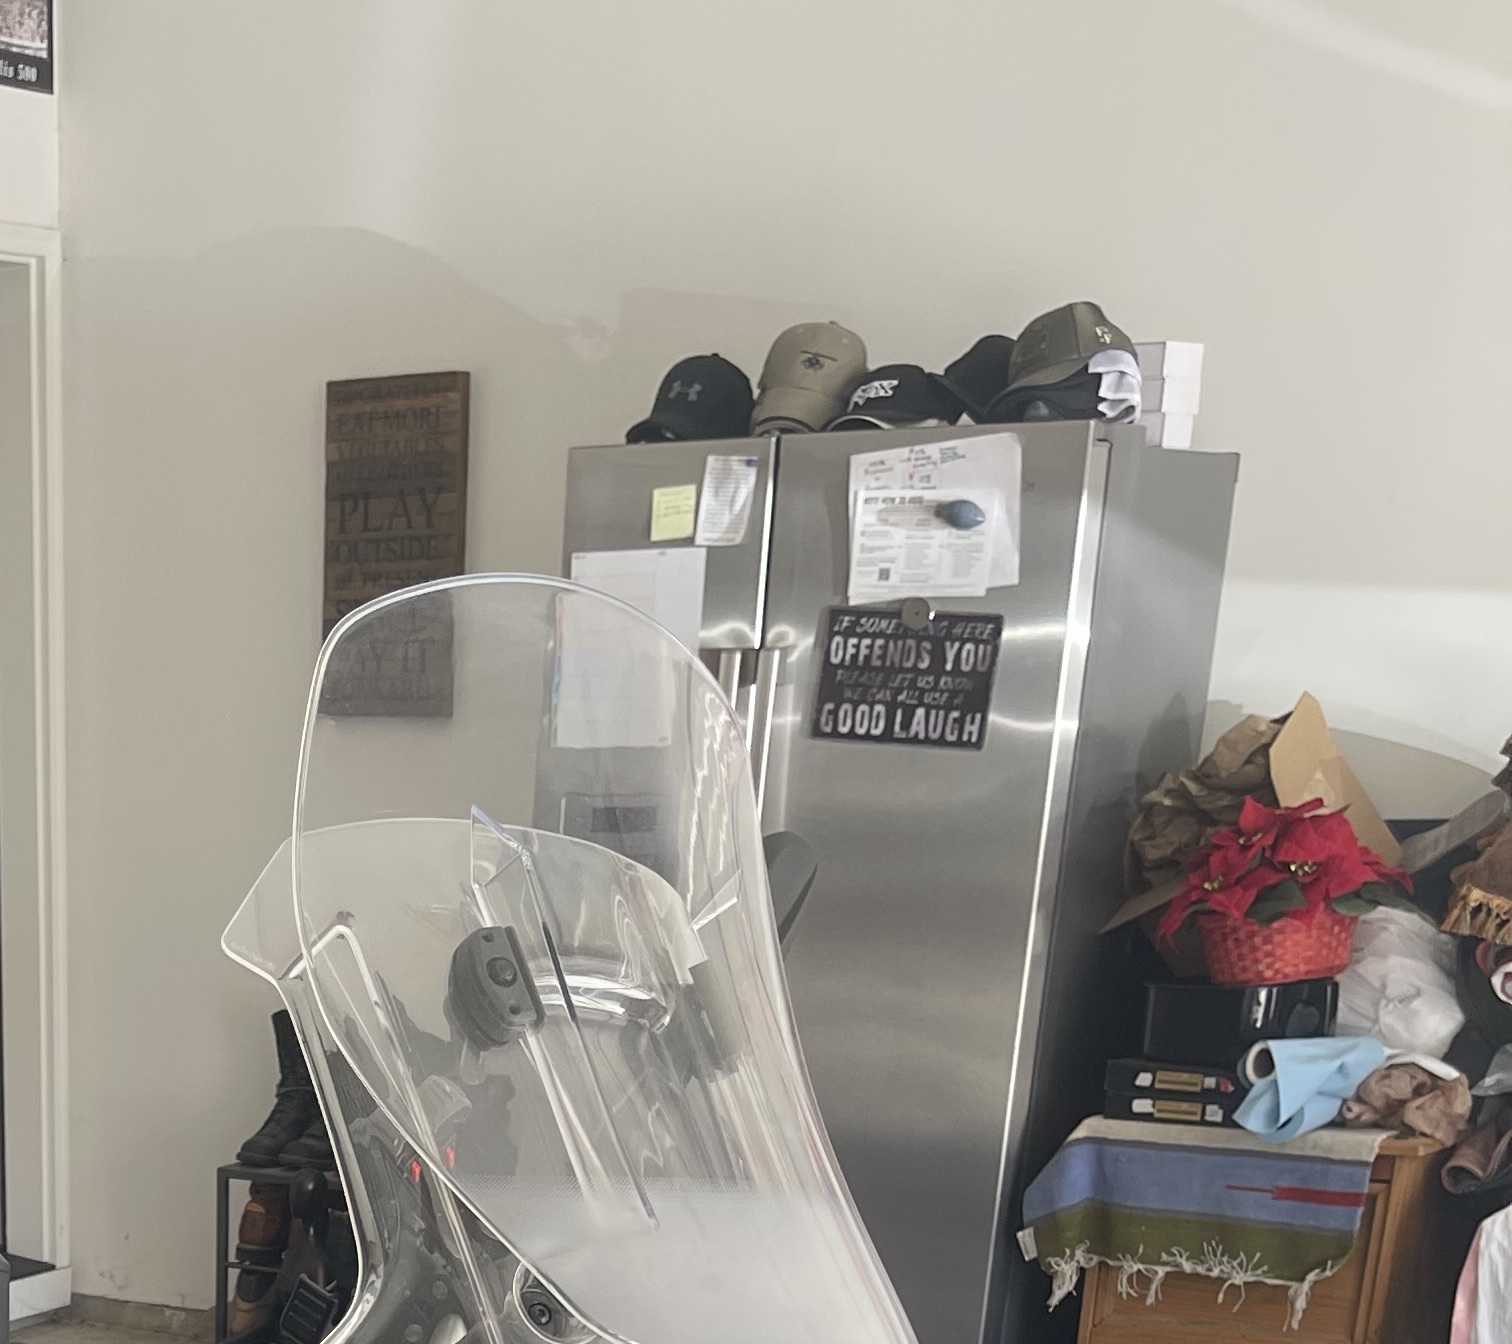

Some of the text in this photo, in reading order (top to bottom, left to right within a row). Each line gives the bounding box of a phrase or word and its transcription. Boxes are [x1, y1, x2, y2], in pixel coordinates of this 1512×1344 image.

[337, 486, 445, 535] PLAY
[829, 635, 991, 672] OFFENDS YOU
[819, 702, 982, 743] GOOD LAUGH
